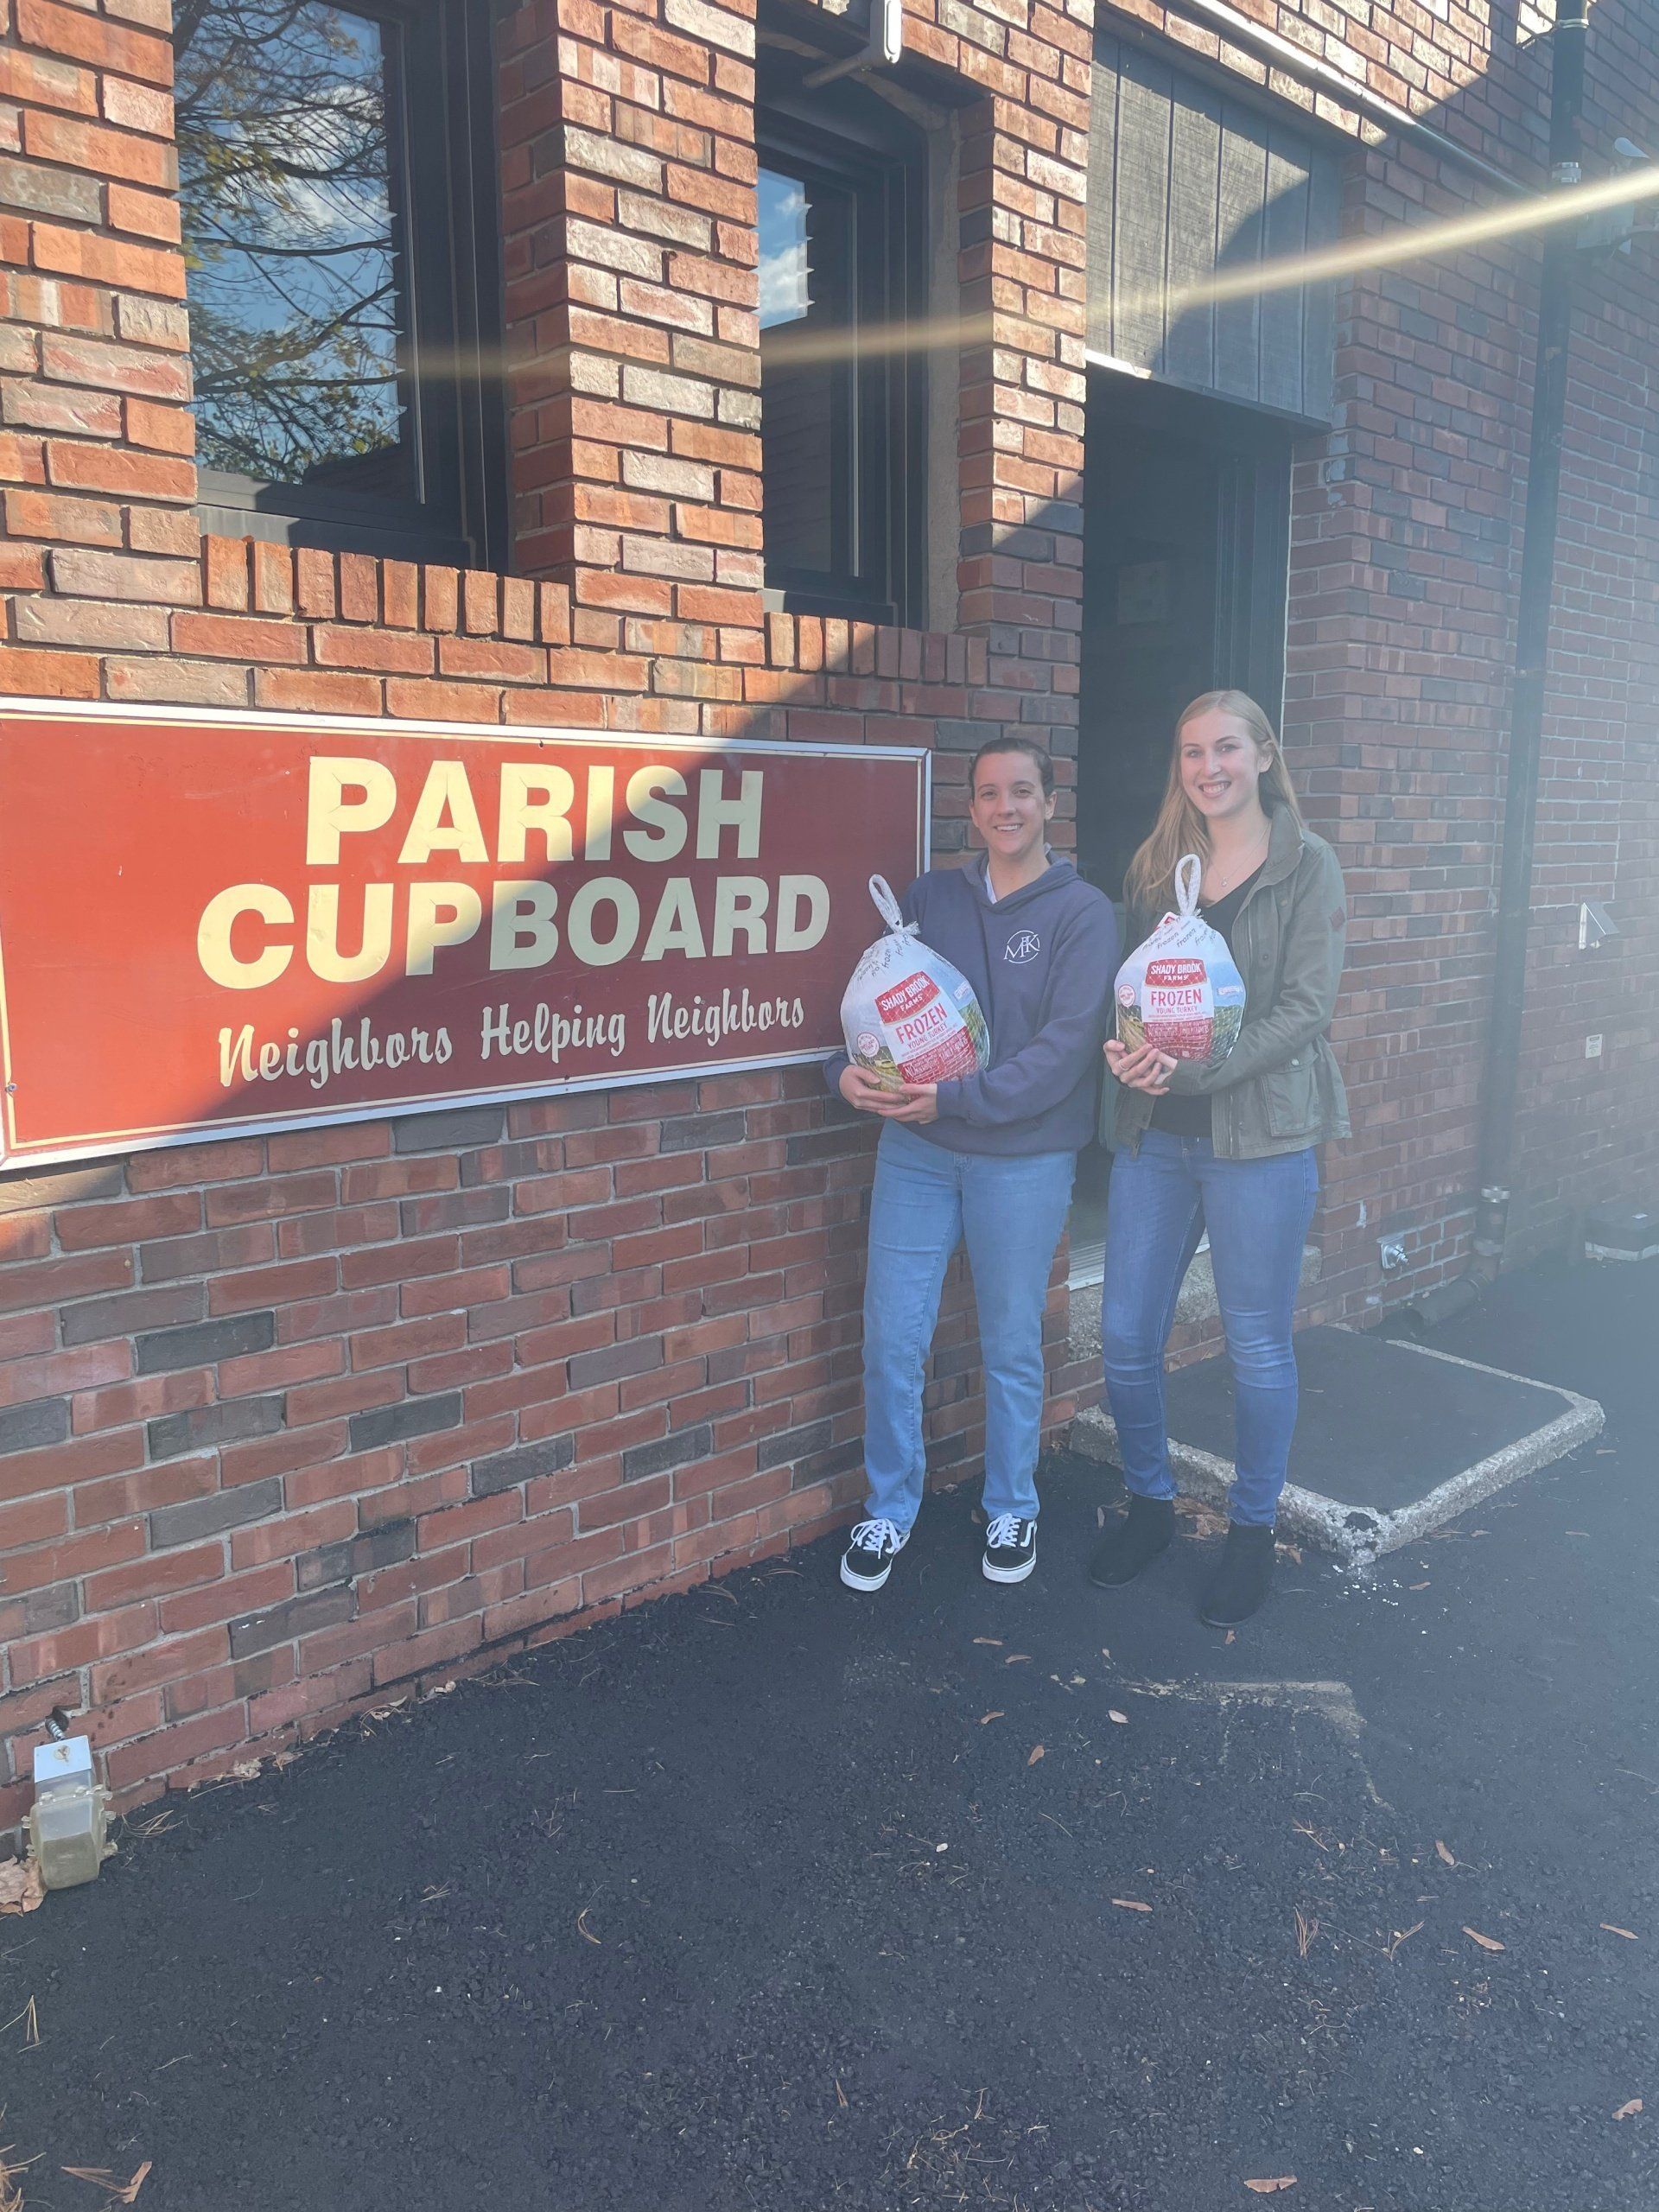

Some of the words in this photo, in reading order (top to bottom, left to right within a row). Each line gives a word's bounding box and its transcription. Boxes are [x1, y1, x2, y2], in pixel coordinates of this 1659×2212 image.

[305, 755, 764, 865] PARISH
[196, 874, 830, 990] CUPBOARD
[1150, 963, 1176, 976] SHADY
[1177, 963, 1201, 974] BROOK
[881, 989, 908, 1011] SHADY
[905, 976, 931, 998] BROOK
[899, 993, 924, 1012] FARMS
[1150, 988, 1202, 1007] FROZEN
[895, 1002, 948, 1044] FROZEN
[1177, 1005, 1198, 1014] TURKEY
[218, 1017, 454, 1090] Neighbors
[480, 1002, 626, 1064] Helping
[646, 988, 805, 1047] Neighbors
[907, 1035, 928, 1049] YOUNG
[927, 1021, 948, 1039] TURKEY
